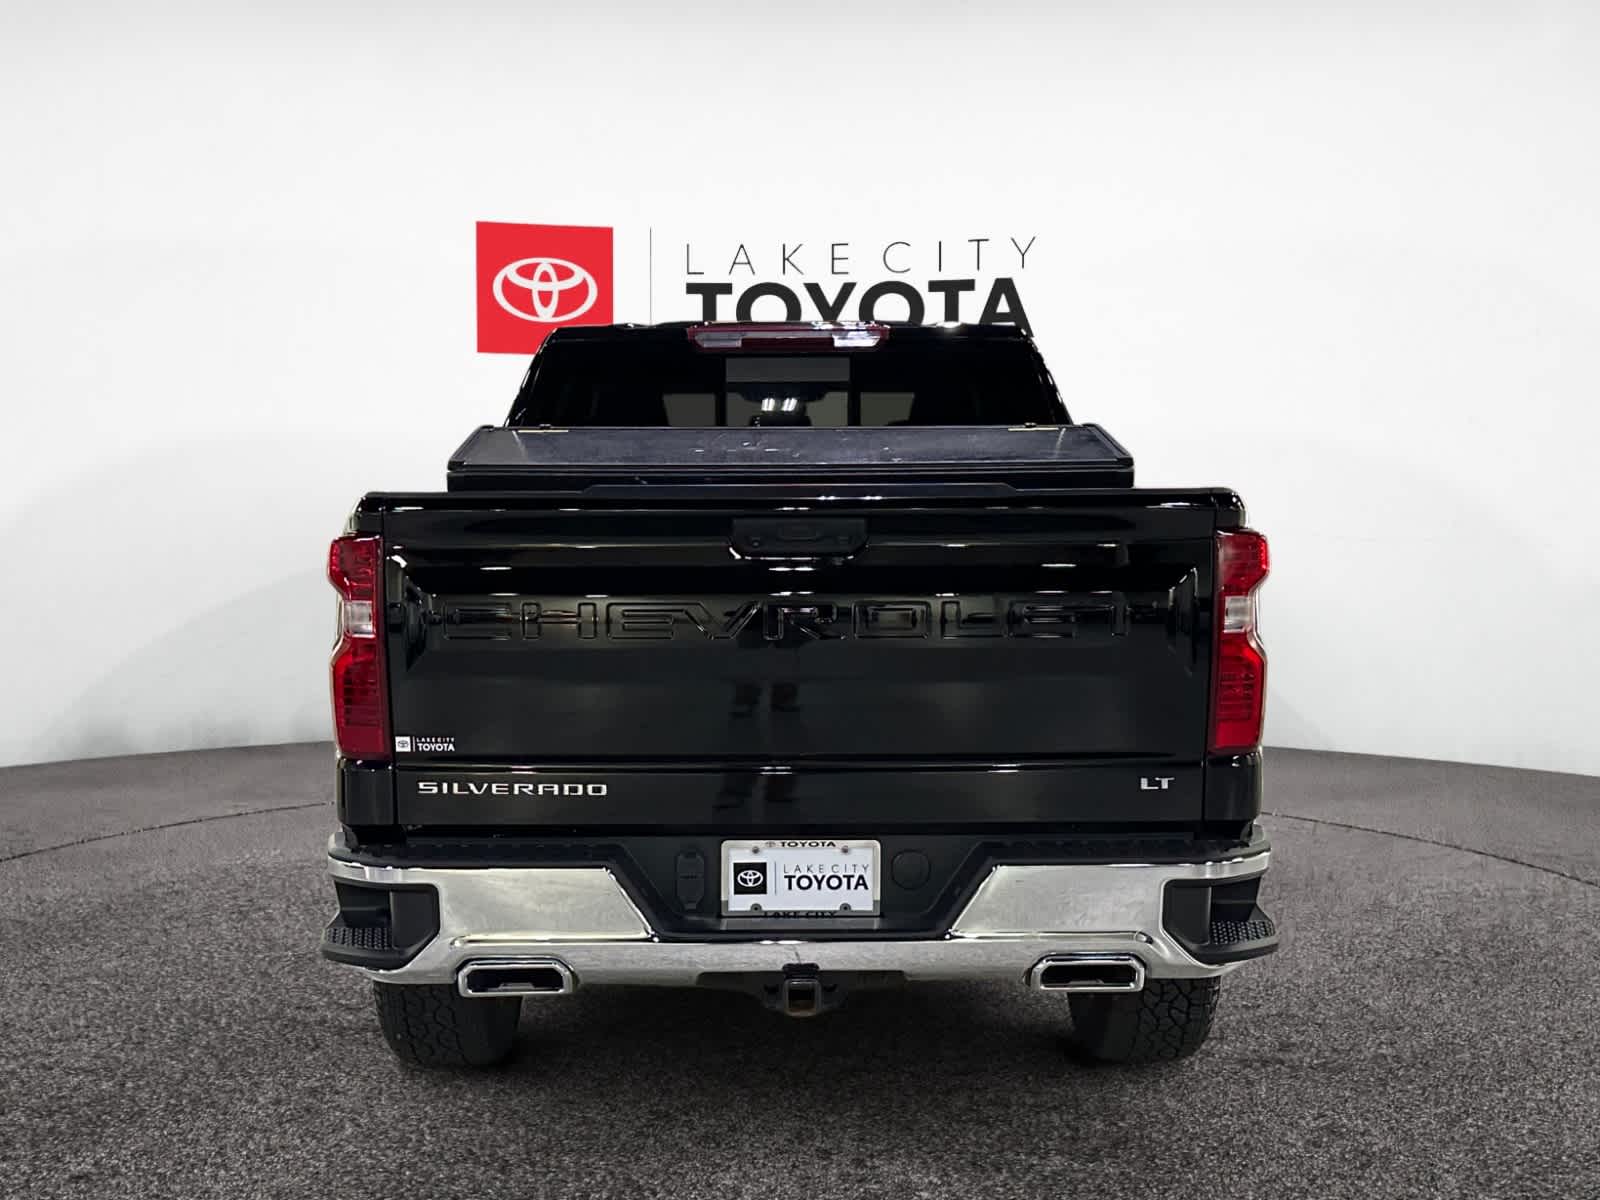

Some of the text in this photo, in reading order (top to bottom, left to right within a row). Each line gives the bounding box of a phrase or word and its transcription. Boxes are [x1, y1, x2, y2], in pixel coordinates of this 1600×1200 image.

[686, 236, 1036, 275] LAKE CITY
[686, 277, 1034, 332] TOYOTA
[443, 600, 1158, 640] CHEVROLET
[417, 743, 456, 752] TOYOTA
[418, 782, 608, 796] SILVERADO
[1140, 777, 1175, 790] LT
[784, 864, 869, 873] LAKE CITY
[784, 874, 869, 891] TOYOTA
